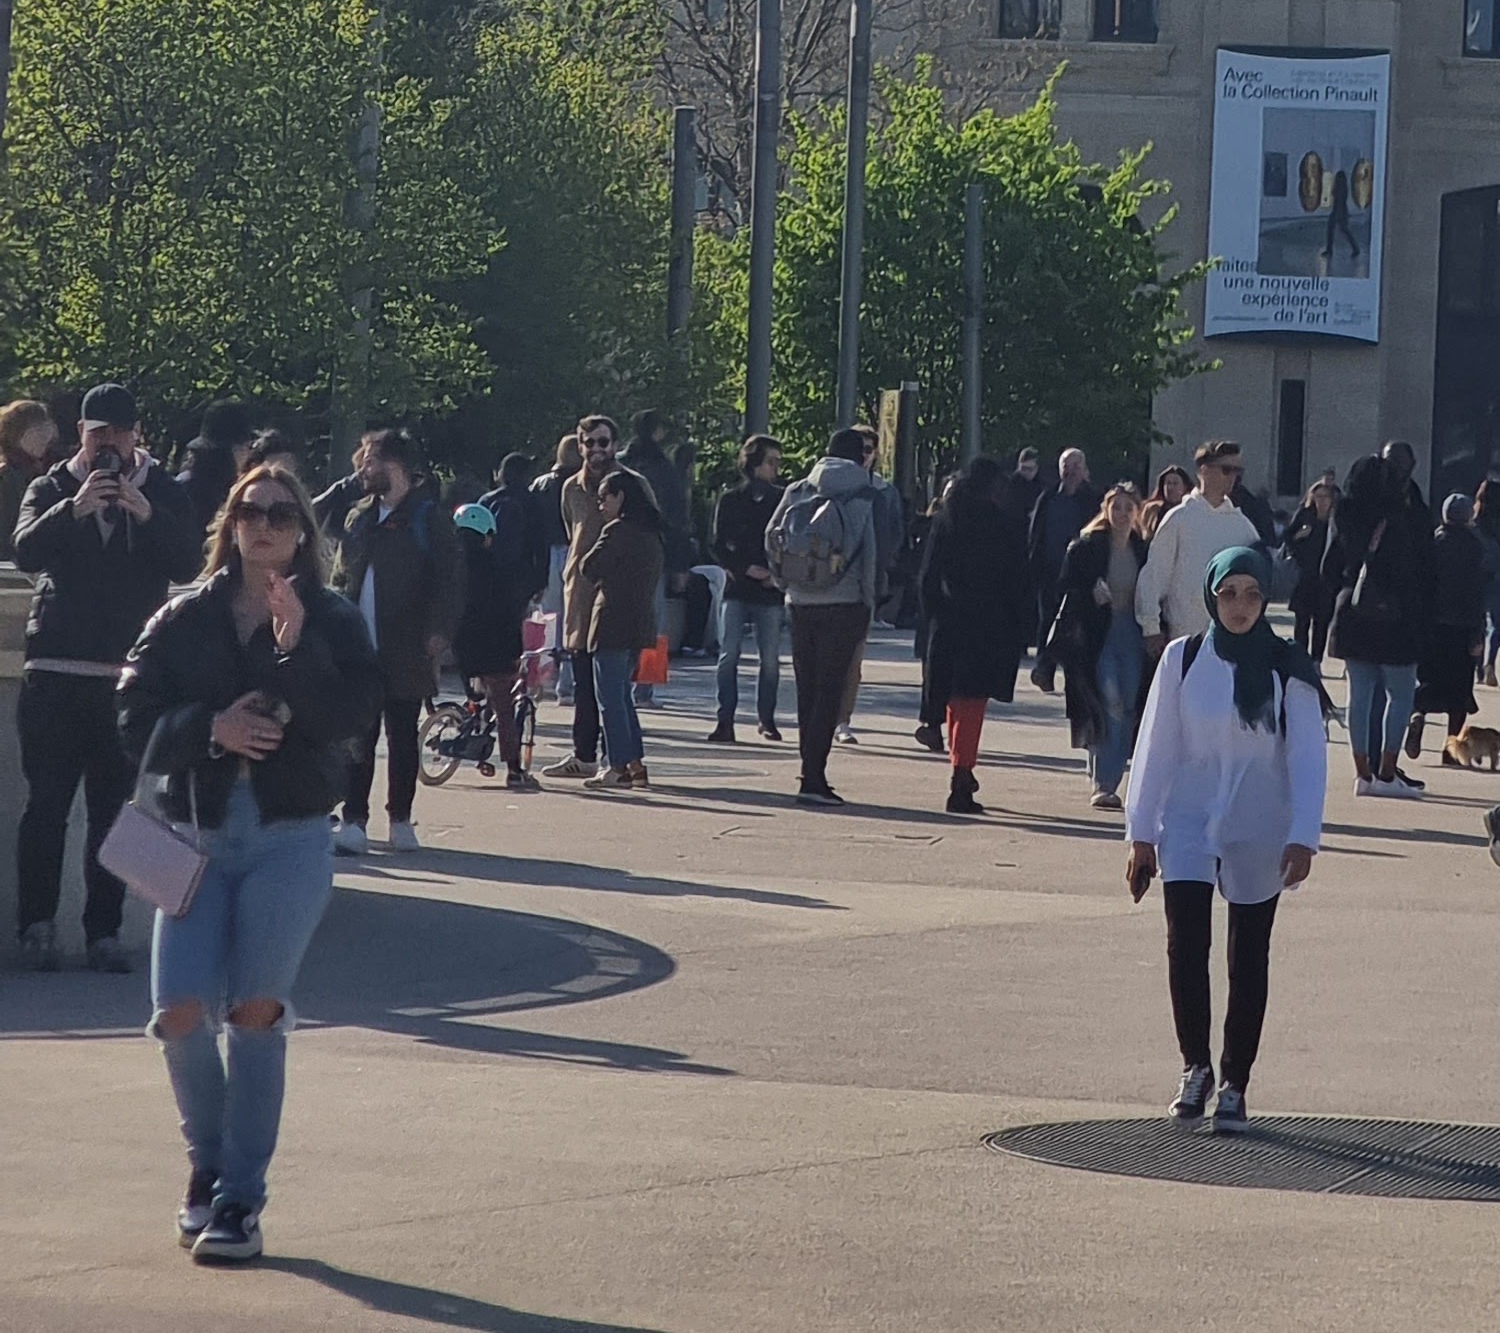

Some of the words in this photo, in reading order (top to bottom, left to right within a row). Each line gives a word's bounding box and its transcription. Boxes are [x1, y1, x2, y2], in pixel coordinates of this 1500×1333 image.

[1223, 66, 1263, 83] Avec
[1223, 84, 1237, 99] la
[1241, 84, 1320, 102] Collection
[1325, 85, 1378, 103] Pinault
[1223, 276, 1254, 289] une
[1260, 276, 1330, 292] nouvelle
[1241, 290, 1329, 309] expérience
[1274, 307, 1294, 322] de
[1299, 307, 1328, 325] l'art
